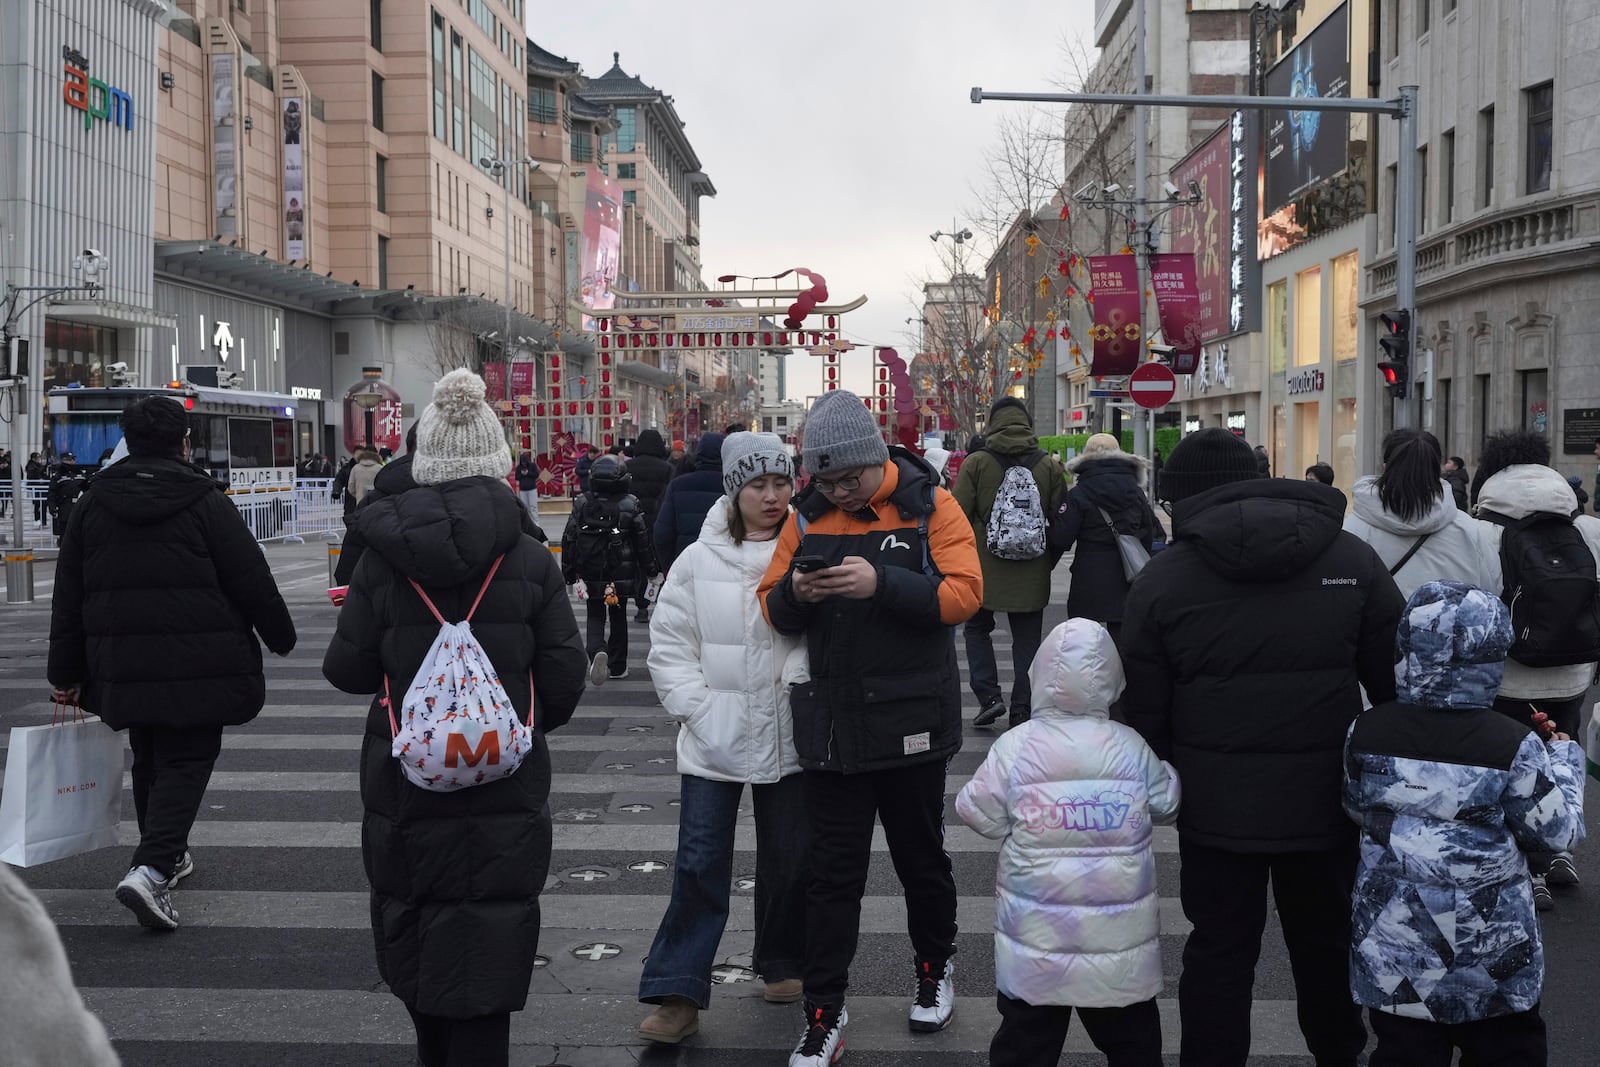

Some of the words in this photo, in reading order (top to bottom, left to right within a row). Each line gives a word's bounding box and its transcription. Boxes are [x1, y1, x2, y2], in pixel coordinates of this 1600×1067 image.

[64, 64, 133, 131] apm
[1321, 577, 1357, 586] Bosideng
[444, 729, 500, 768] M
[57, 781, 96, 795] NIKE.COM
[1020, 800, 1131, 832] BUNNY
